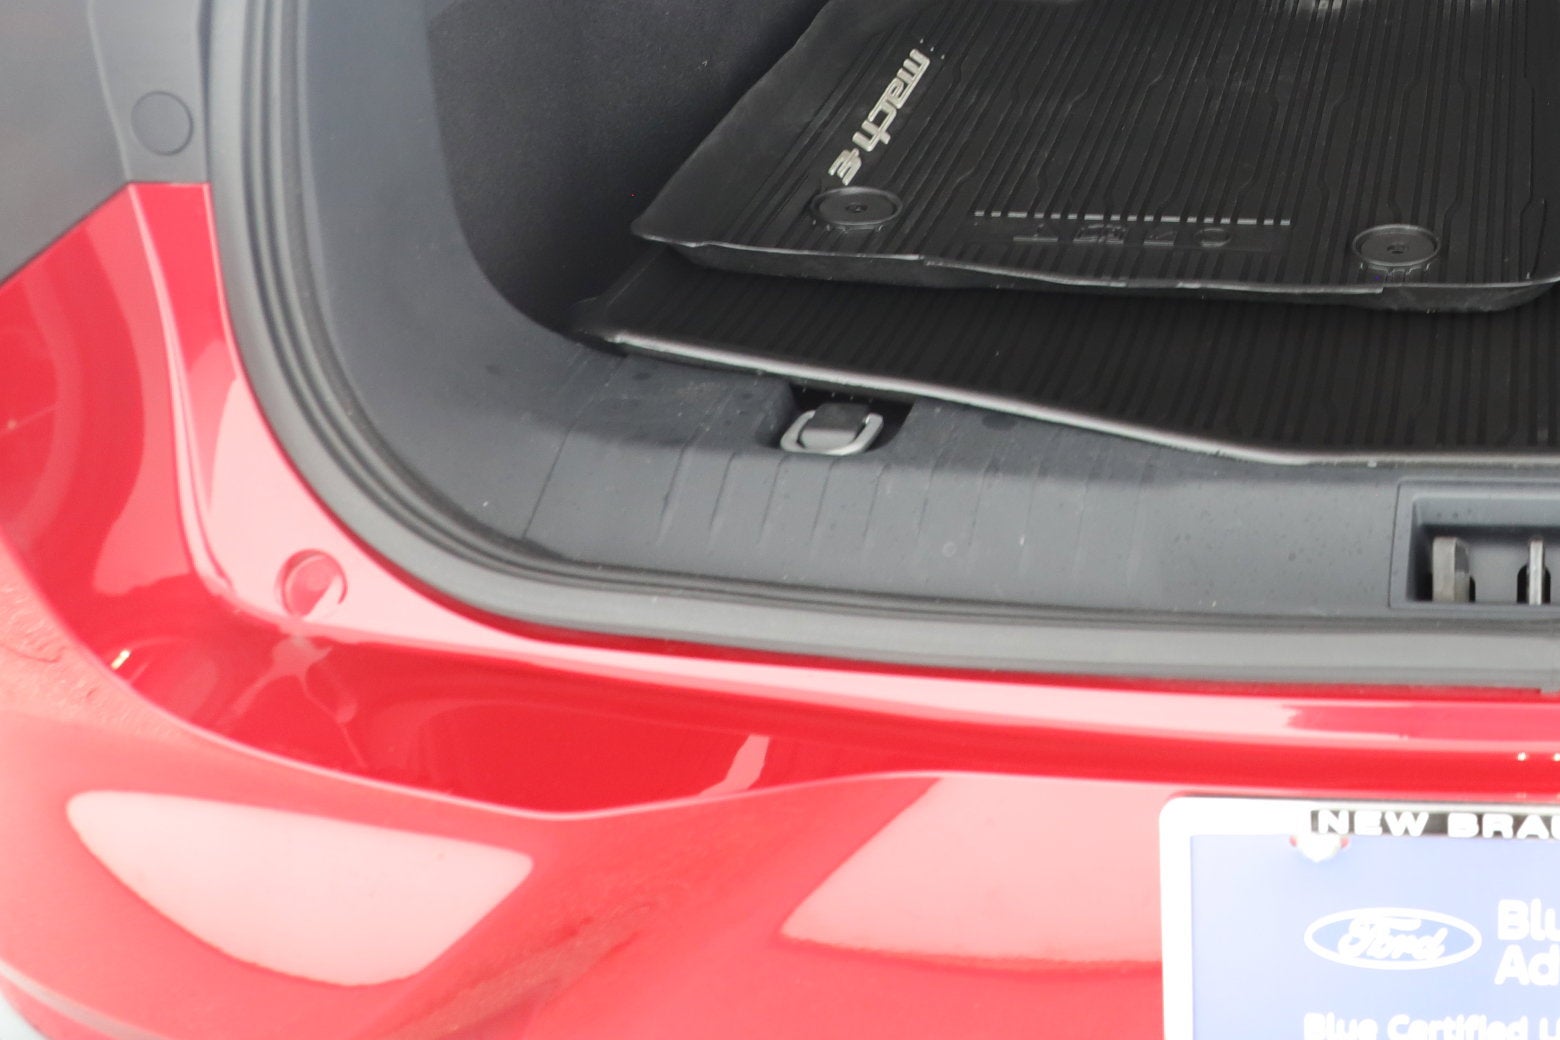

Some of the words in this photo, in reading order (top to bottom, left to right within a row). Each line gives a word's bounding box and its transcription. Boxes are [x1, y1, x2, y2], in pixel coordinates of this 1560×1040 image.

[1318, 809, 1429, 837] NEW
[1338, 913, 1449, 960] Ford
[1303, 1011, 1378, 1040] Blue
[1387, 1013, 1529, 1040] Certified
